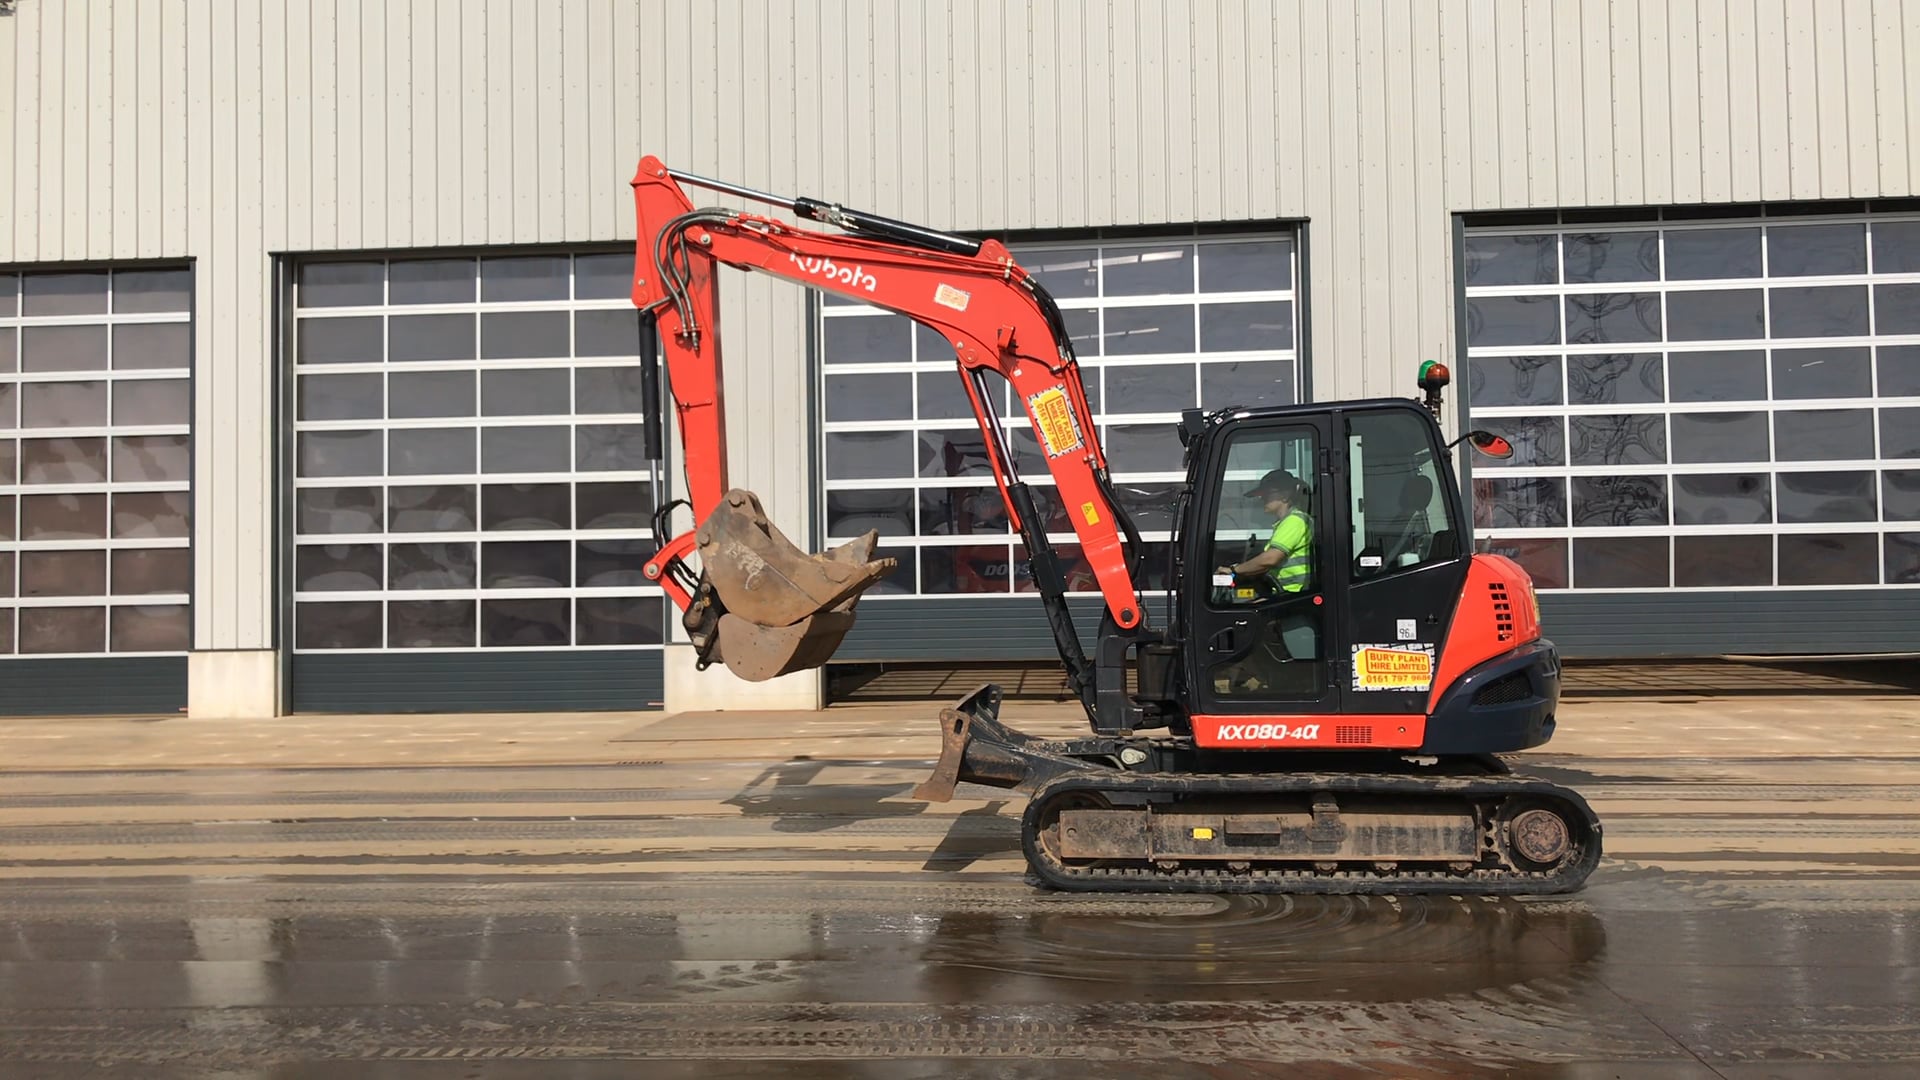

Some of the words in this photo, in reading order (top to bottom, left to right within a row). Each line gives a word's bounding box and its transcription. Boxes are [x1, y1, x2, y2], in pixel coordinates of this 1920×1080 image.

[790, 252, 877, 292] Kubota
[1056, 399, 1067, 420] BURY
[1063, 421, 1074, 444] PLANT
[1399, 628, 1410, 639] 96
[1370, 653, 1395, 662] BURY
[1398, 655, 1426, 663] PLANT
[1370, 662, 1391, 670] HIRE
[1366, 674, 1388, 683] 0161
[1391, 674, 1408, 682] 797
